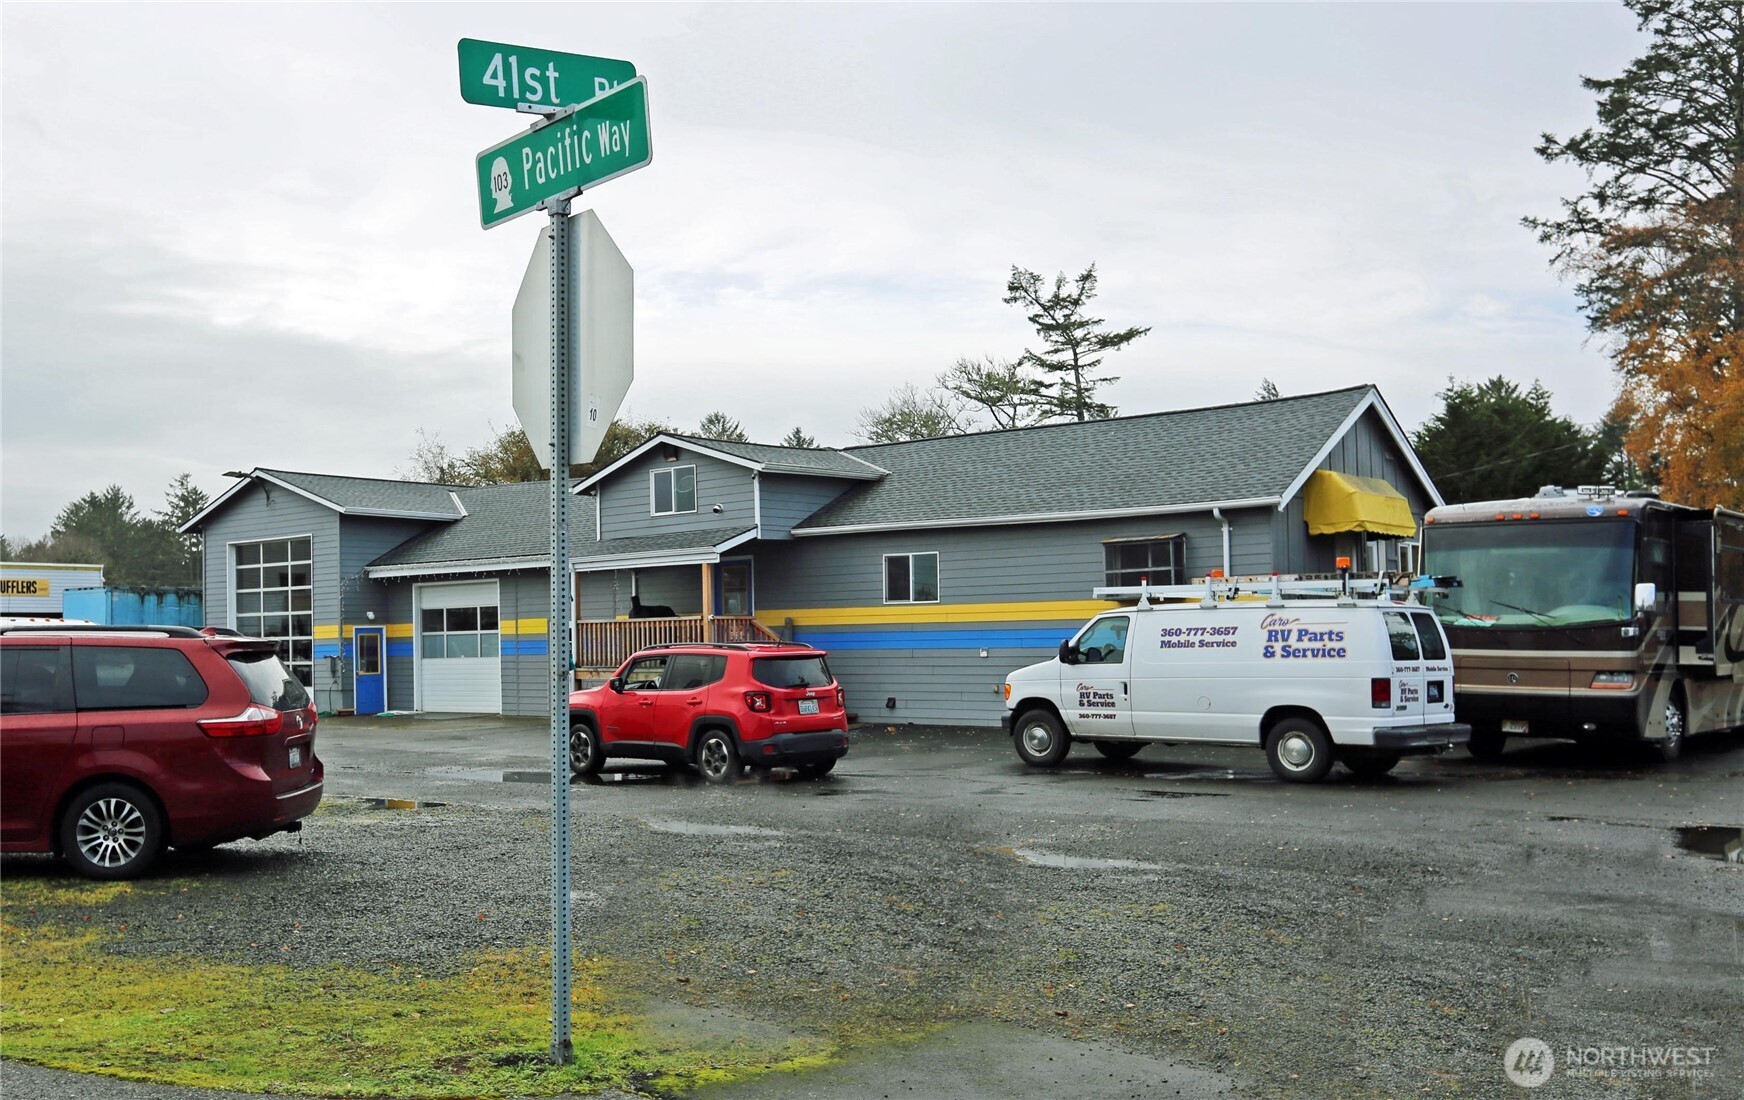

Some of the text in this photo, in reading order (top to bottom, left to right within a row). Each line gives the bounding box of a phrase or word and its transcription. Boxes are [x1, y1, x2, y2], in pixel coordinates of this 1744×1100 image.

[482, 53, 618, 104] 41st P
[522, 119, 631, 190] Pacific Way
[493, 171, 509, 193] 103
[589, 408, 598, 421] 10
[1160, 626, 1238, 637] 360-777-3657
[1266, 629, 1344, 643] RV Parts
[1160, 638, 1237, 649] Mobile Service
[1262, 644, 1347, 659] & Service
[1086, 699, 1116, 708] Service
